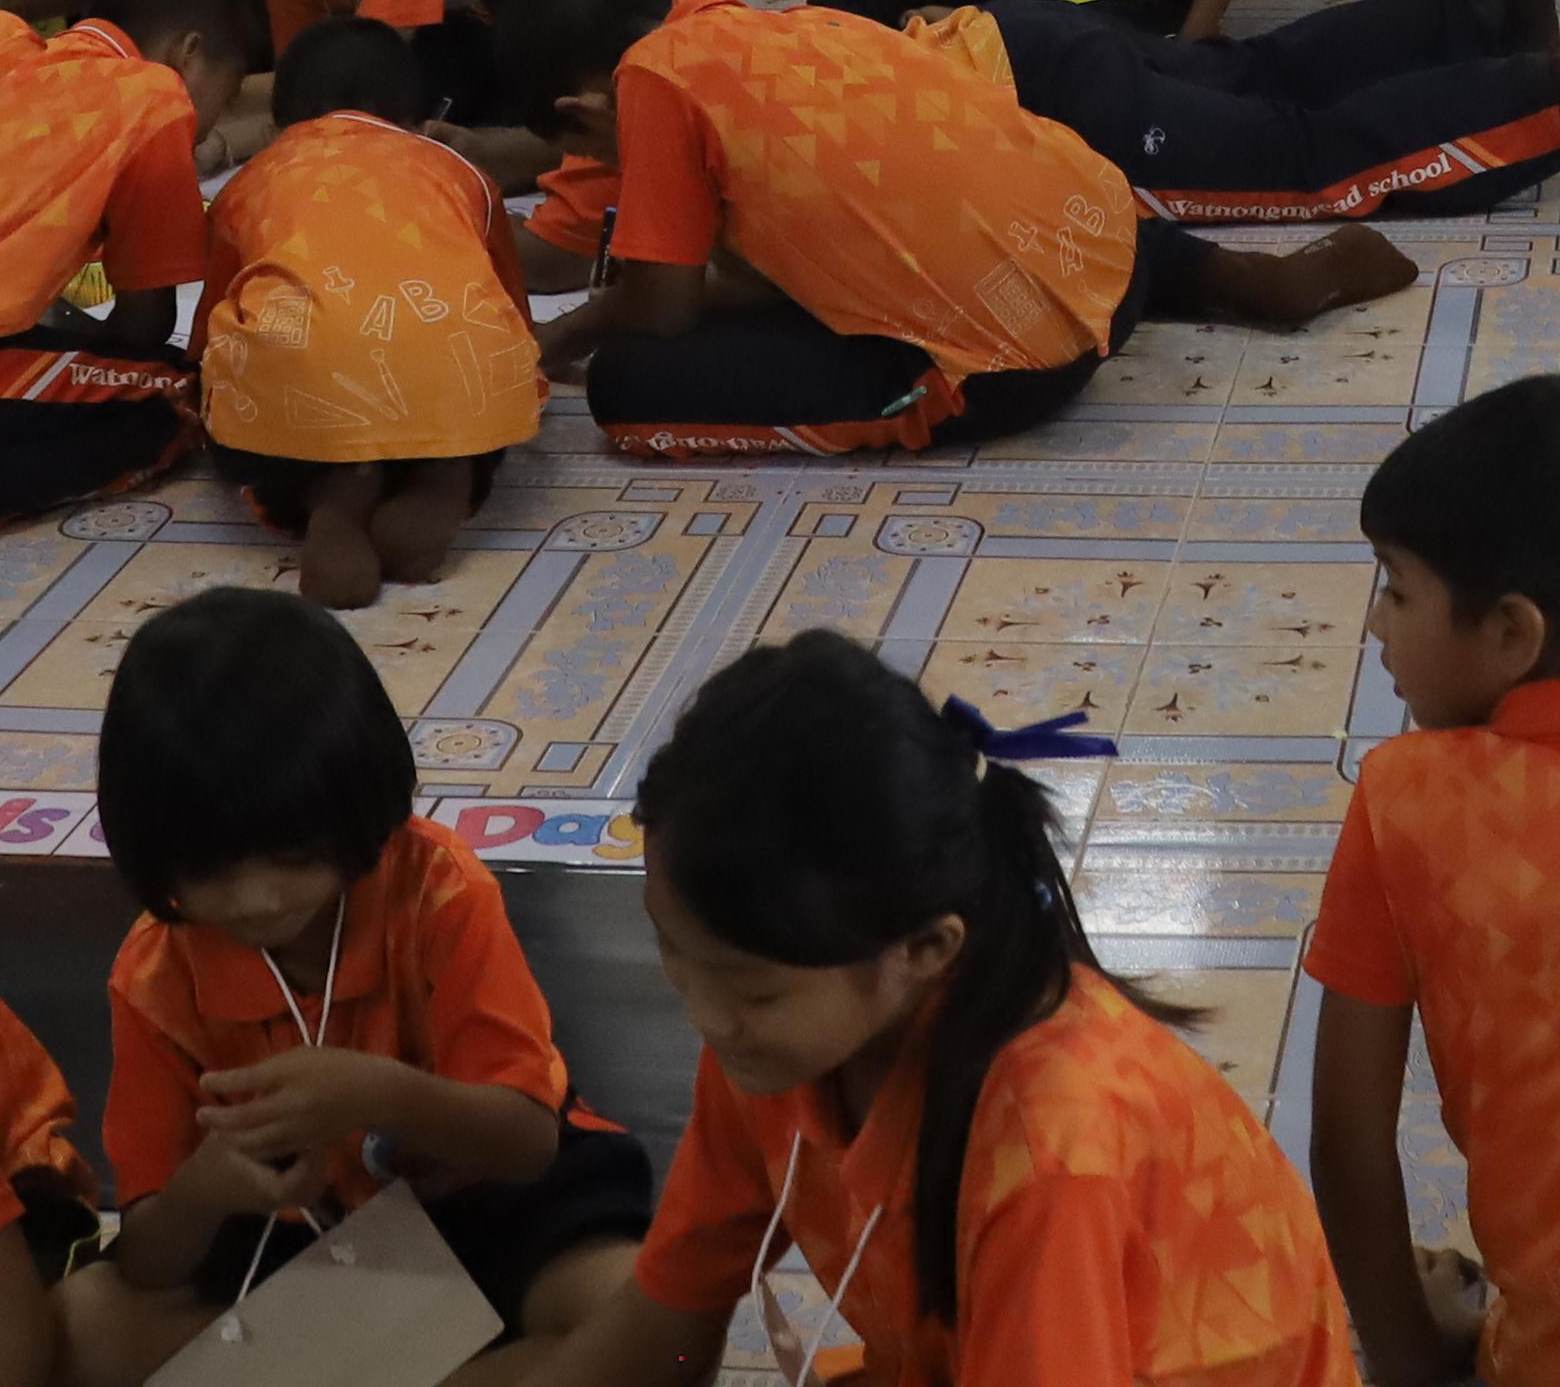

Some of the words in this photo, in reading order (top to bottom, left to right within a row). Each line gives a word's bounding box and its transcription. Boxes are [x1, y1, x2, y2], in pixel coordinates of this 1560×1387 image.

[1368, 153, 1453, 198] school
[359, 294, 396, 342] A
[398, 279, 450, 323] B
[454, 805, 643, 860] Day
